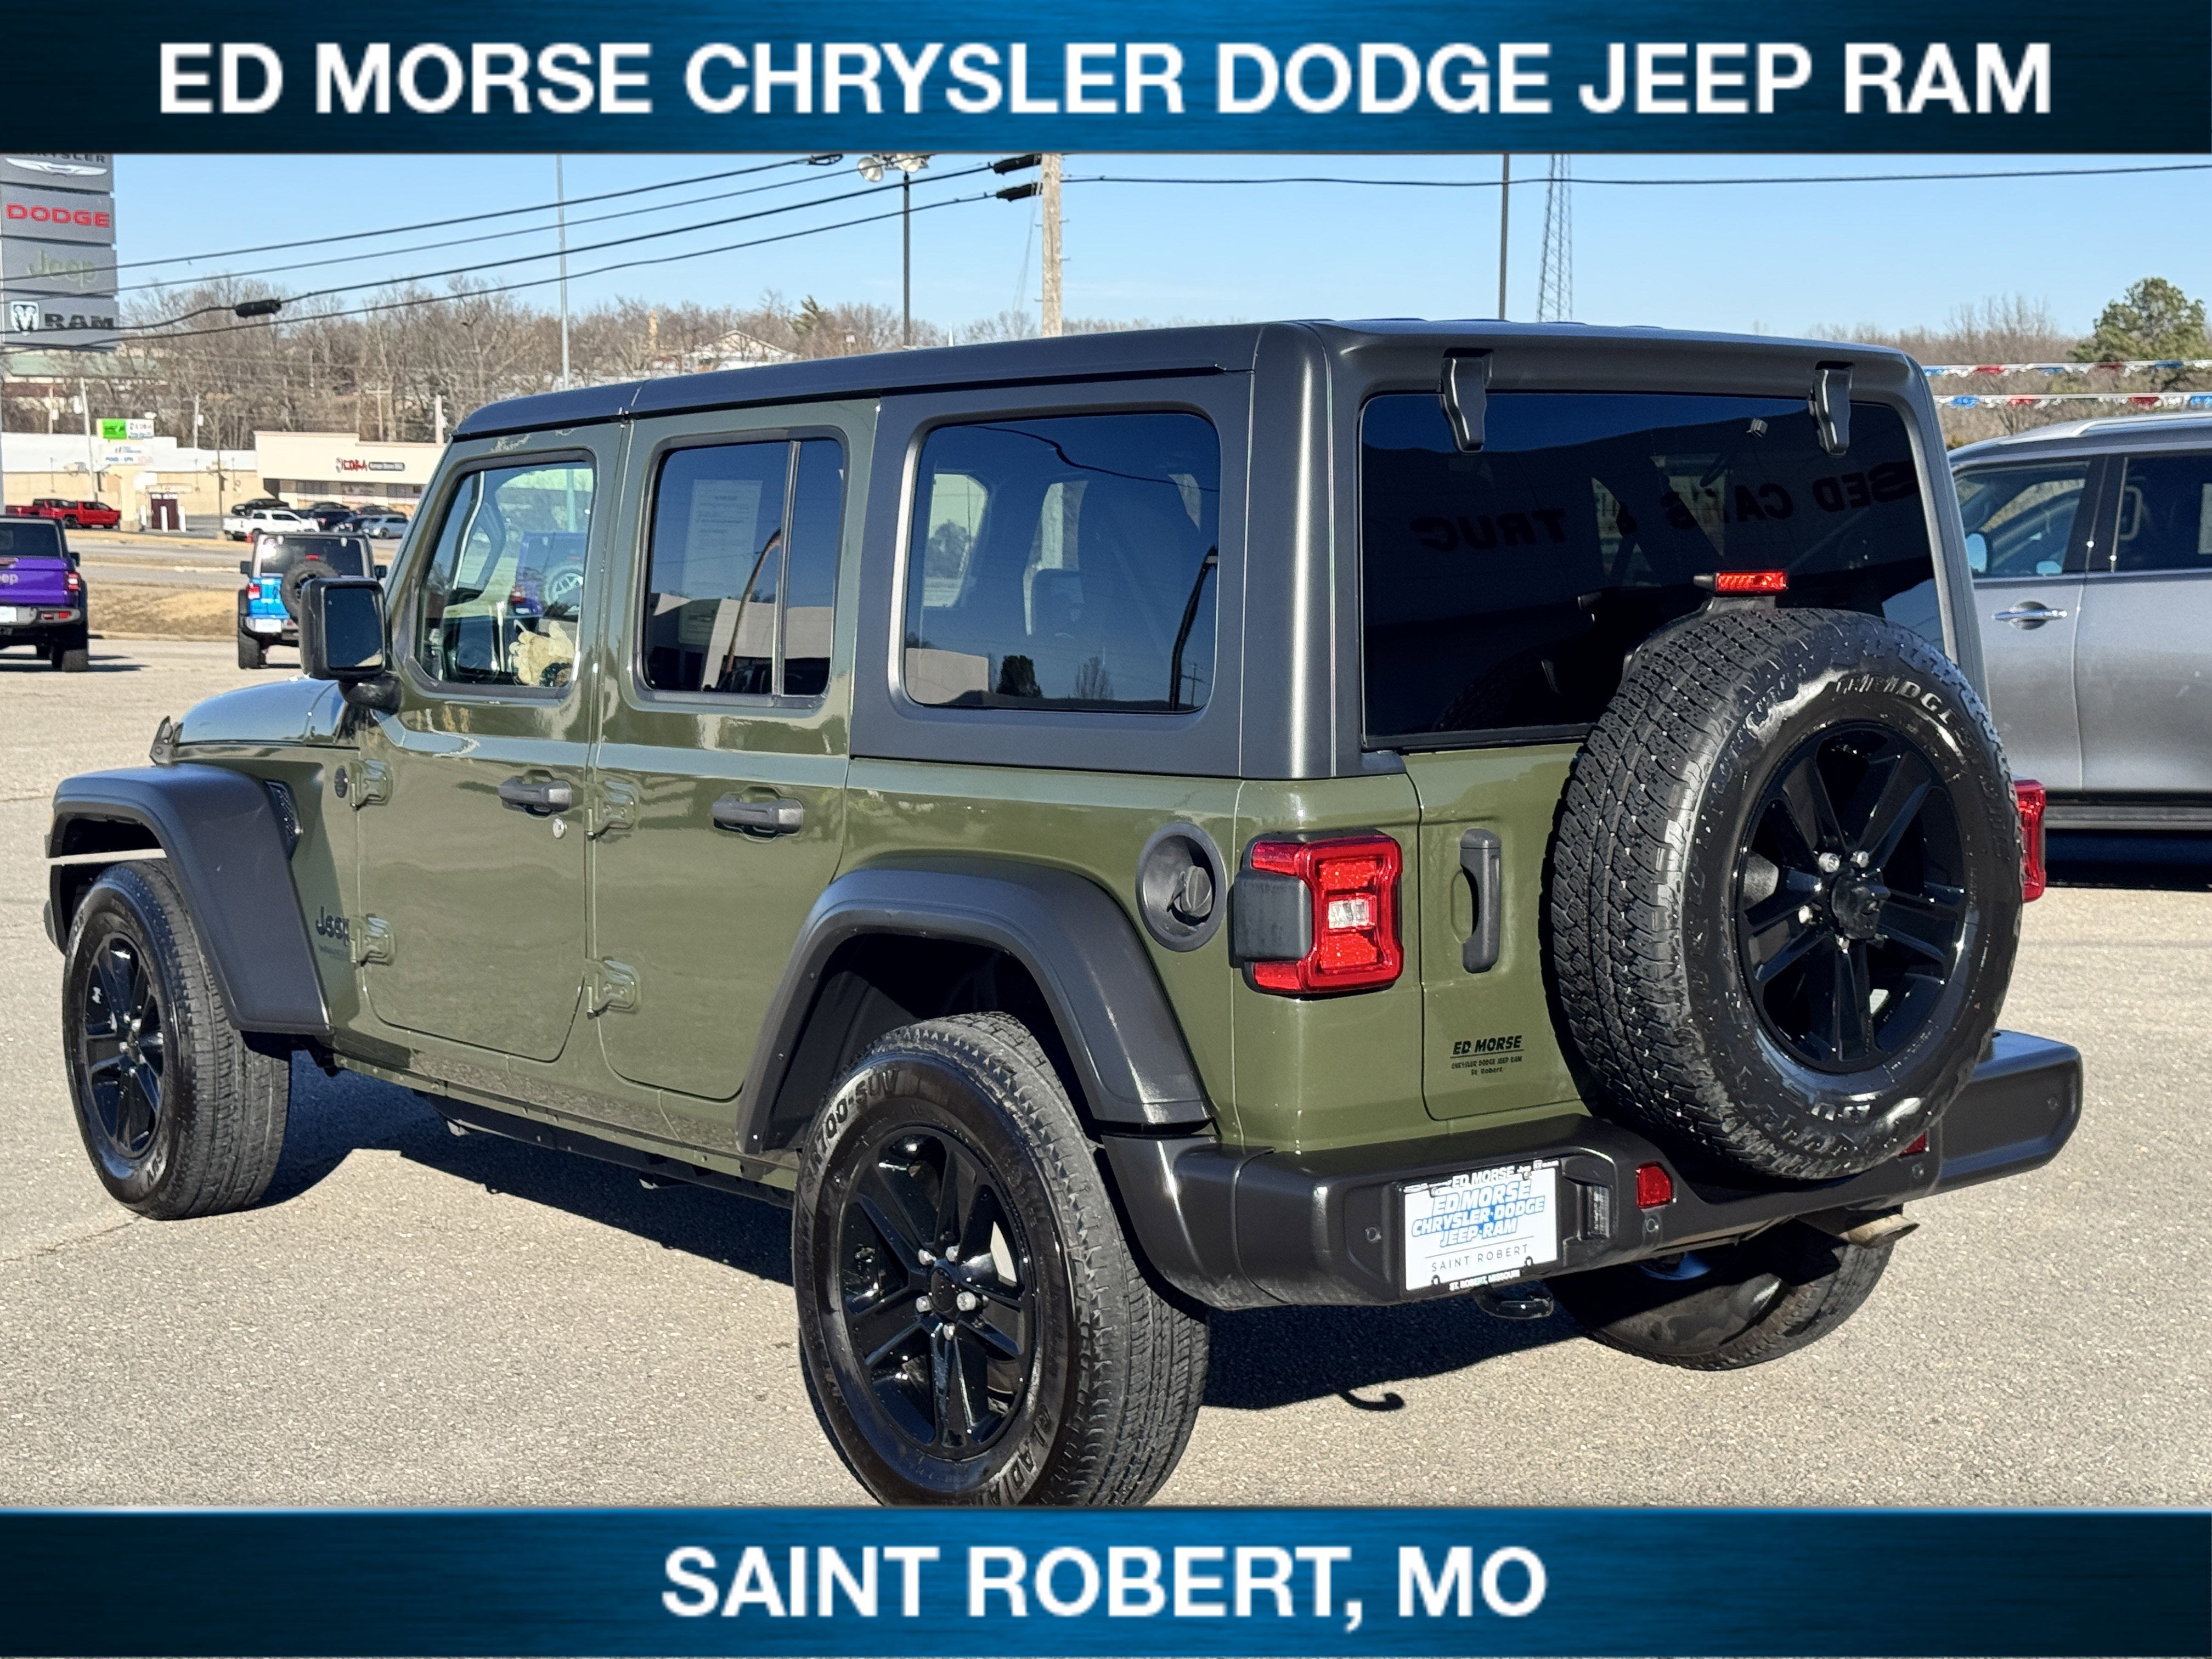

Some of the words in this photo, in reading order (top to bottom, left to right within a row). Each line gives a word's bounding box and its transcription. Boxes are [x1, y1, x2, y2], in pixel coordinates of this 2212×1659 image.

[7, 203, 109, 228] DODGE
[27, 249, 98, 290] Jeep
[44, 313, 114, 329] RAM
[315, 906, 349, 947] Jeep
[1453, 1040, 1471, 1055] ED
[1474, 1035, 1522, 1053] MORSE
[1452, 1174, 1470, 1188] ED
[1471, 1165, 1515, 1186] MORSE
[1432, 1193, 1460, 1217] ED
[1460, 1180, 1531, 1211] MORSE
[1431, 1256, 1470, 1272] SAINT
[1477, 1244, 1528, 1263] ROBERT
